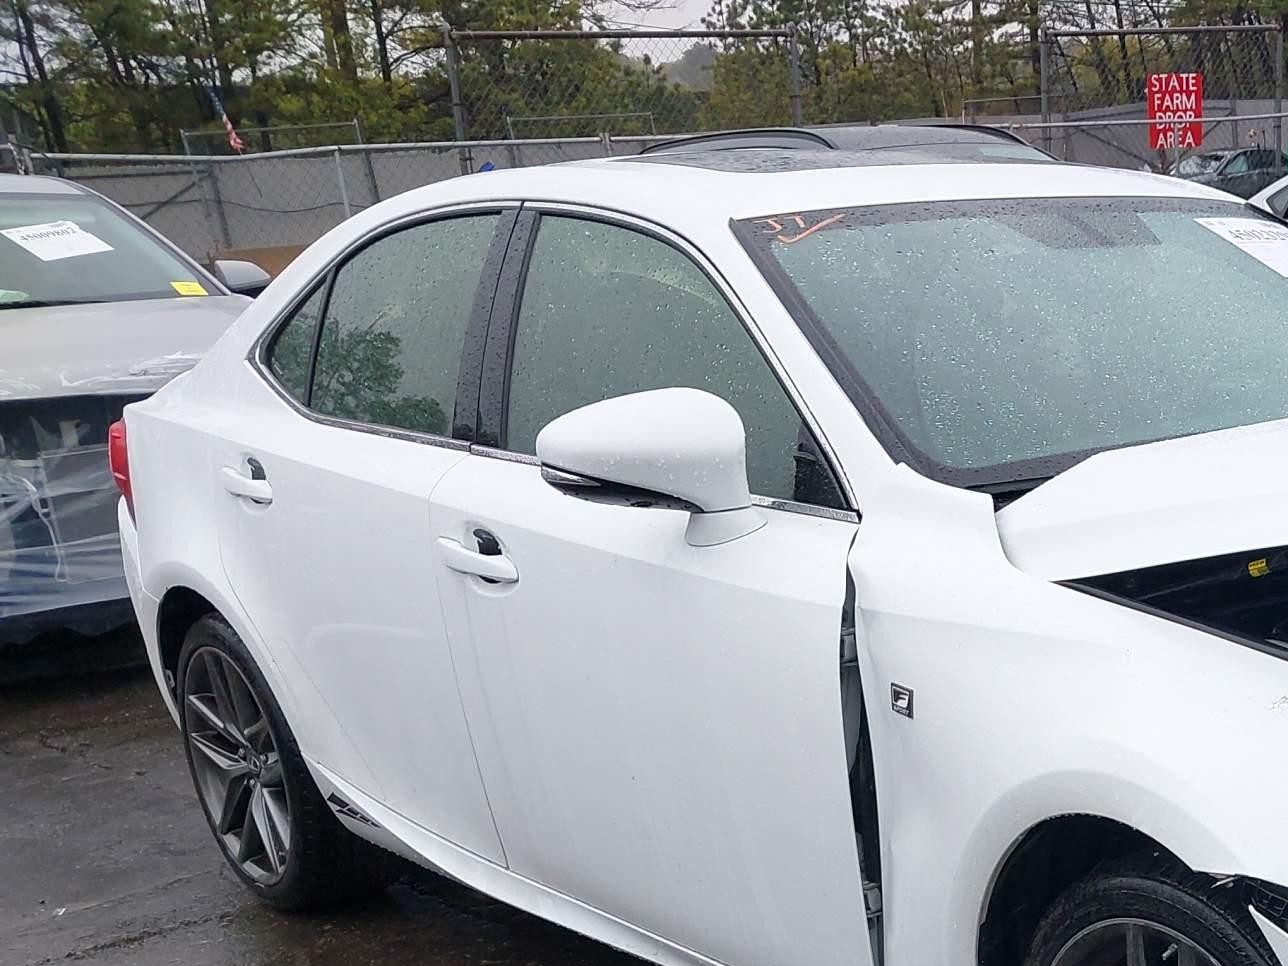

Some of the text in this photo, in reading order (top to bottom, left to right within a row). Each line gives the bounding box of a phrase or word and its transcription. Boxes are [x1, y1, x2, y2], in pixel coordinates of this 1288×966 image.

[1151, 73, 1197, 92] STATE
[1154, 93, 1196, 111] FARM
[1155, 111, 1195, 129] DROP
[1156, 131, 1196, 149] AREA
